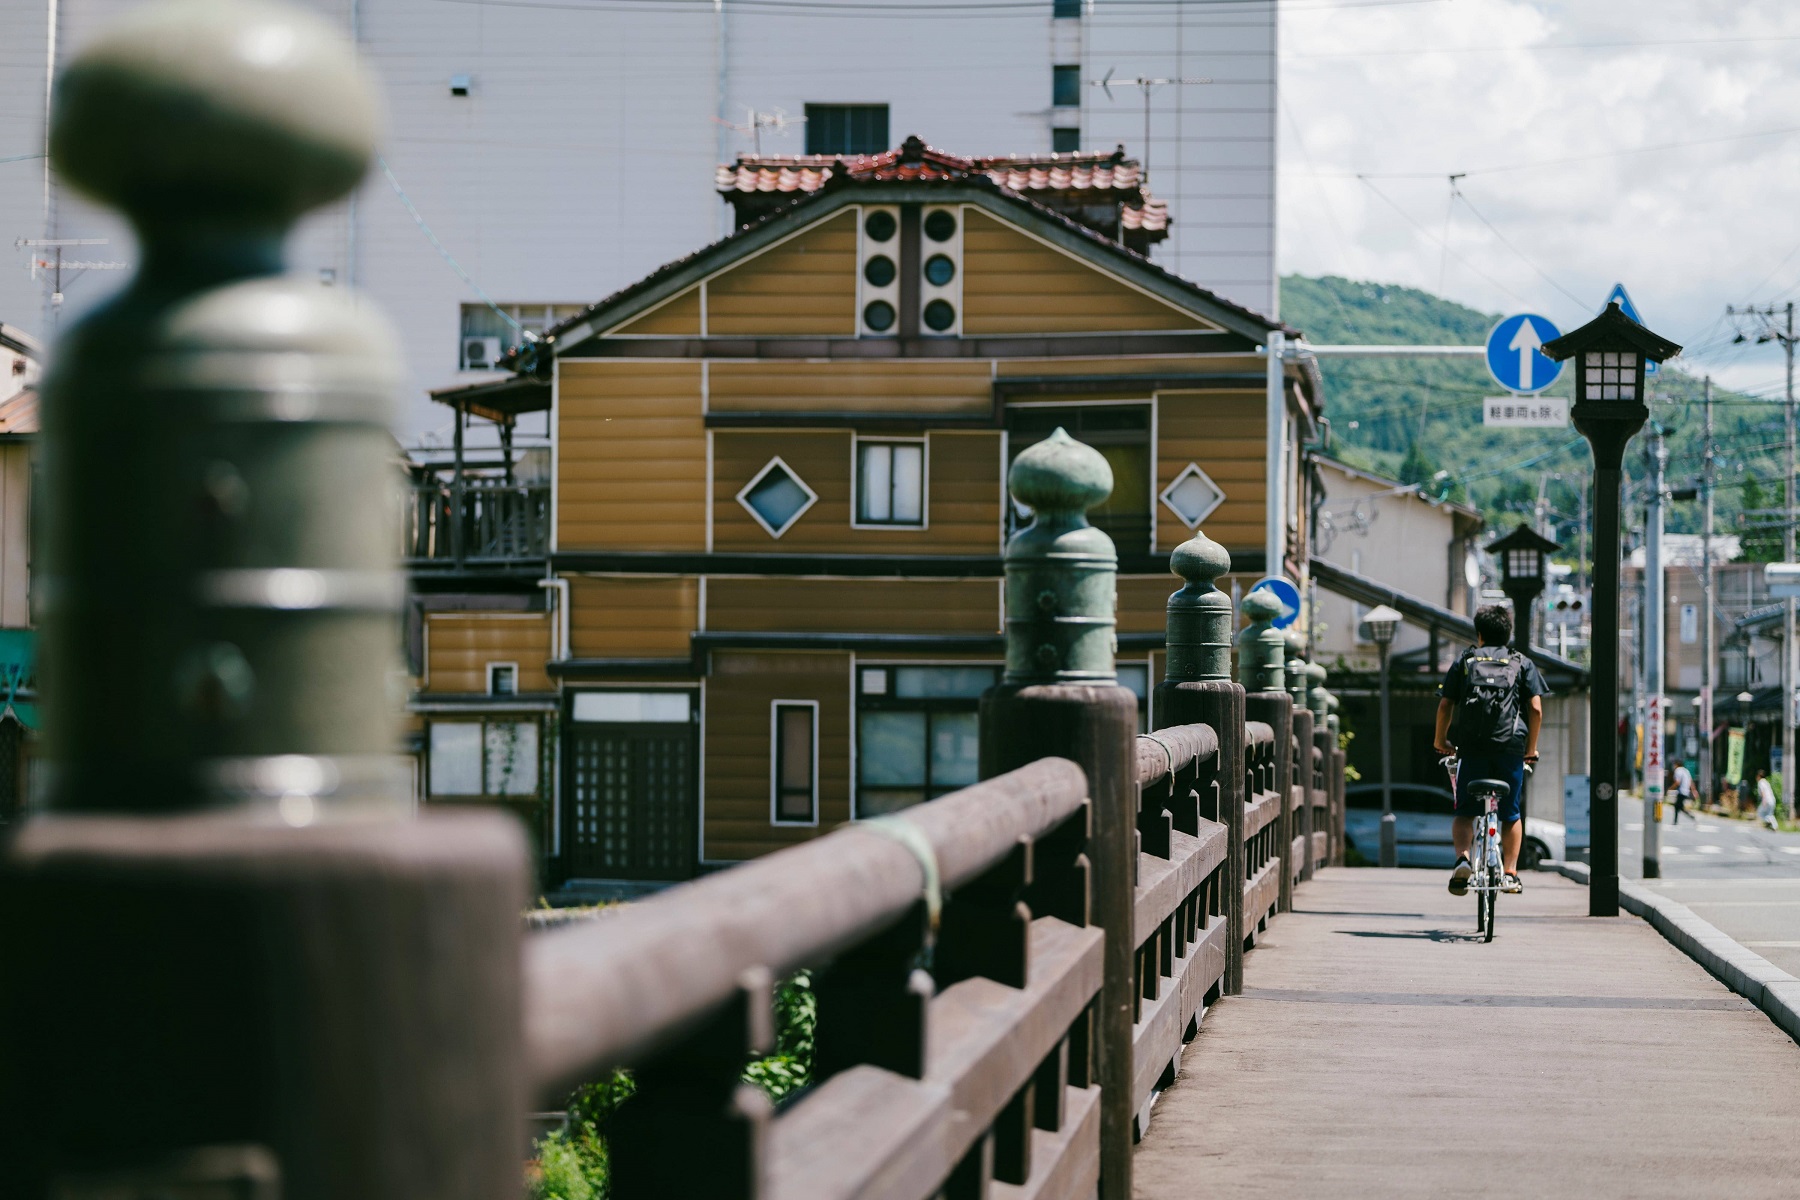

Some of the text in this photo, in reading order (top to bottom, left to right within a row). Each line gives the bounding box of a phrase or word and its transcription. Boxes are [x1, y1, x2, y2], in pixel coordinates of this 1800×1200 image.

[1490, 404, 1561, 420] 軽車両を除く
